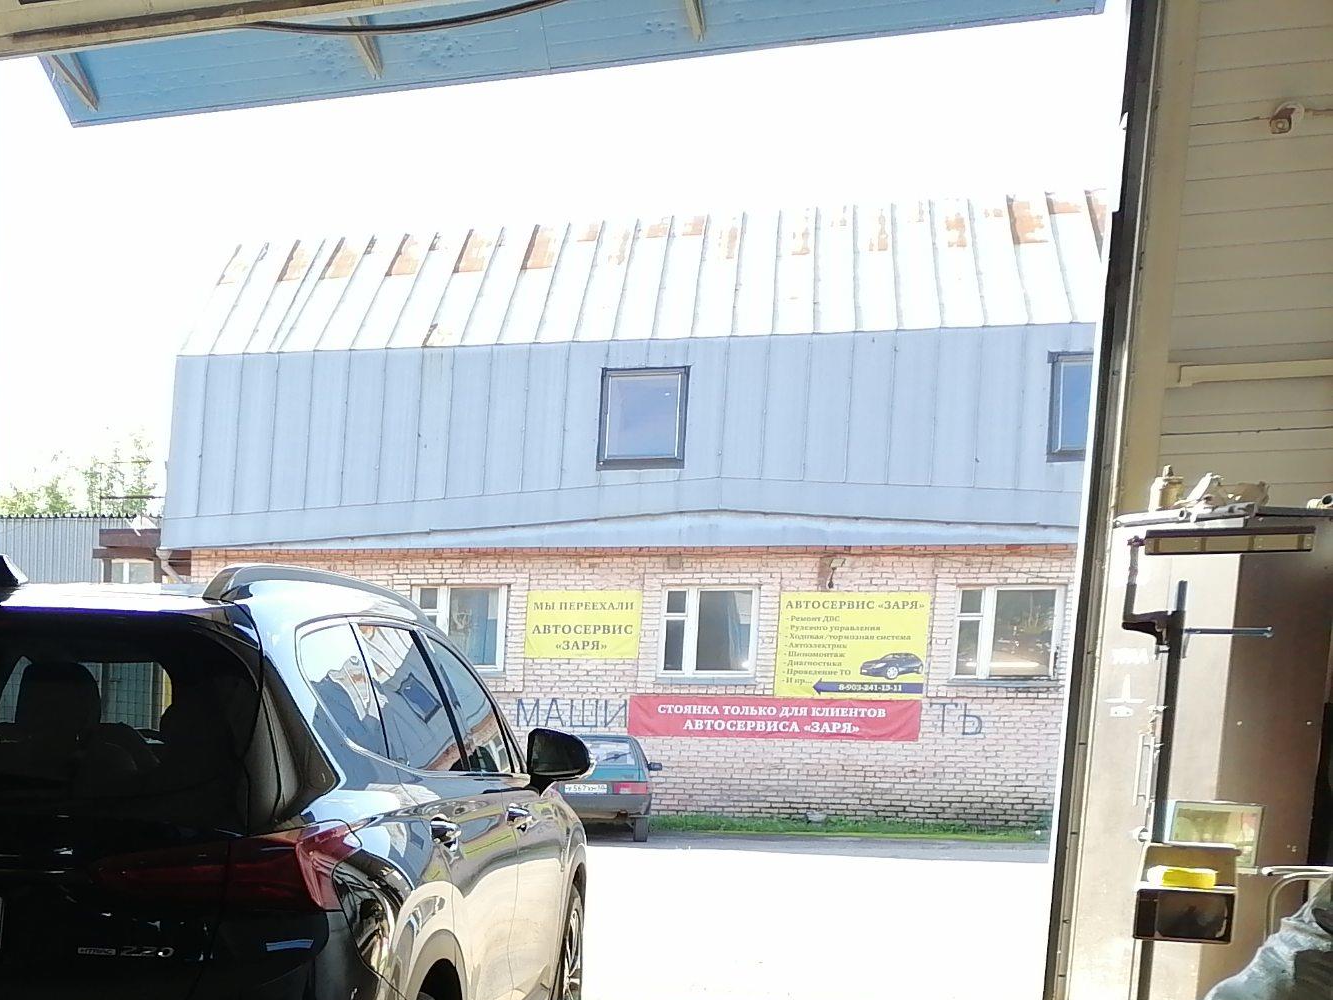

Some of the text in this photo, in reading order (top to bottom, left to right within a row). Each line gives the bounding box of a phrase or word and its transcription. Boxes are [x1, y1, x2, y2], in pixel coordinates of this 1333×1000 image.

[533, 602, 634, 610] МЫ ПЕРЕЕХАЛИ
[785, 600, 875, 610] АВТОСЕРВИС
[532, 624, 633, 634] АВТОСЕРВИС
[555, 640, 607, 650] «ЗАРЯ»
[657, 704, 887, 718] СТОЯНКА ТОЛЬКО ДЛЯ КЛИЕНТОВ
[683, 720, 859, 734] АВТОСЕРВИСА «ЗАРЯ»
